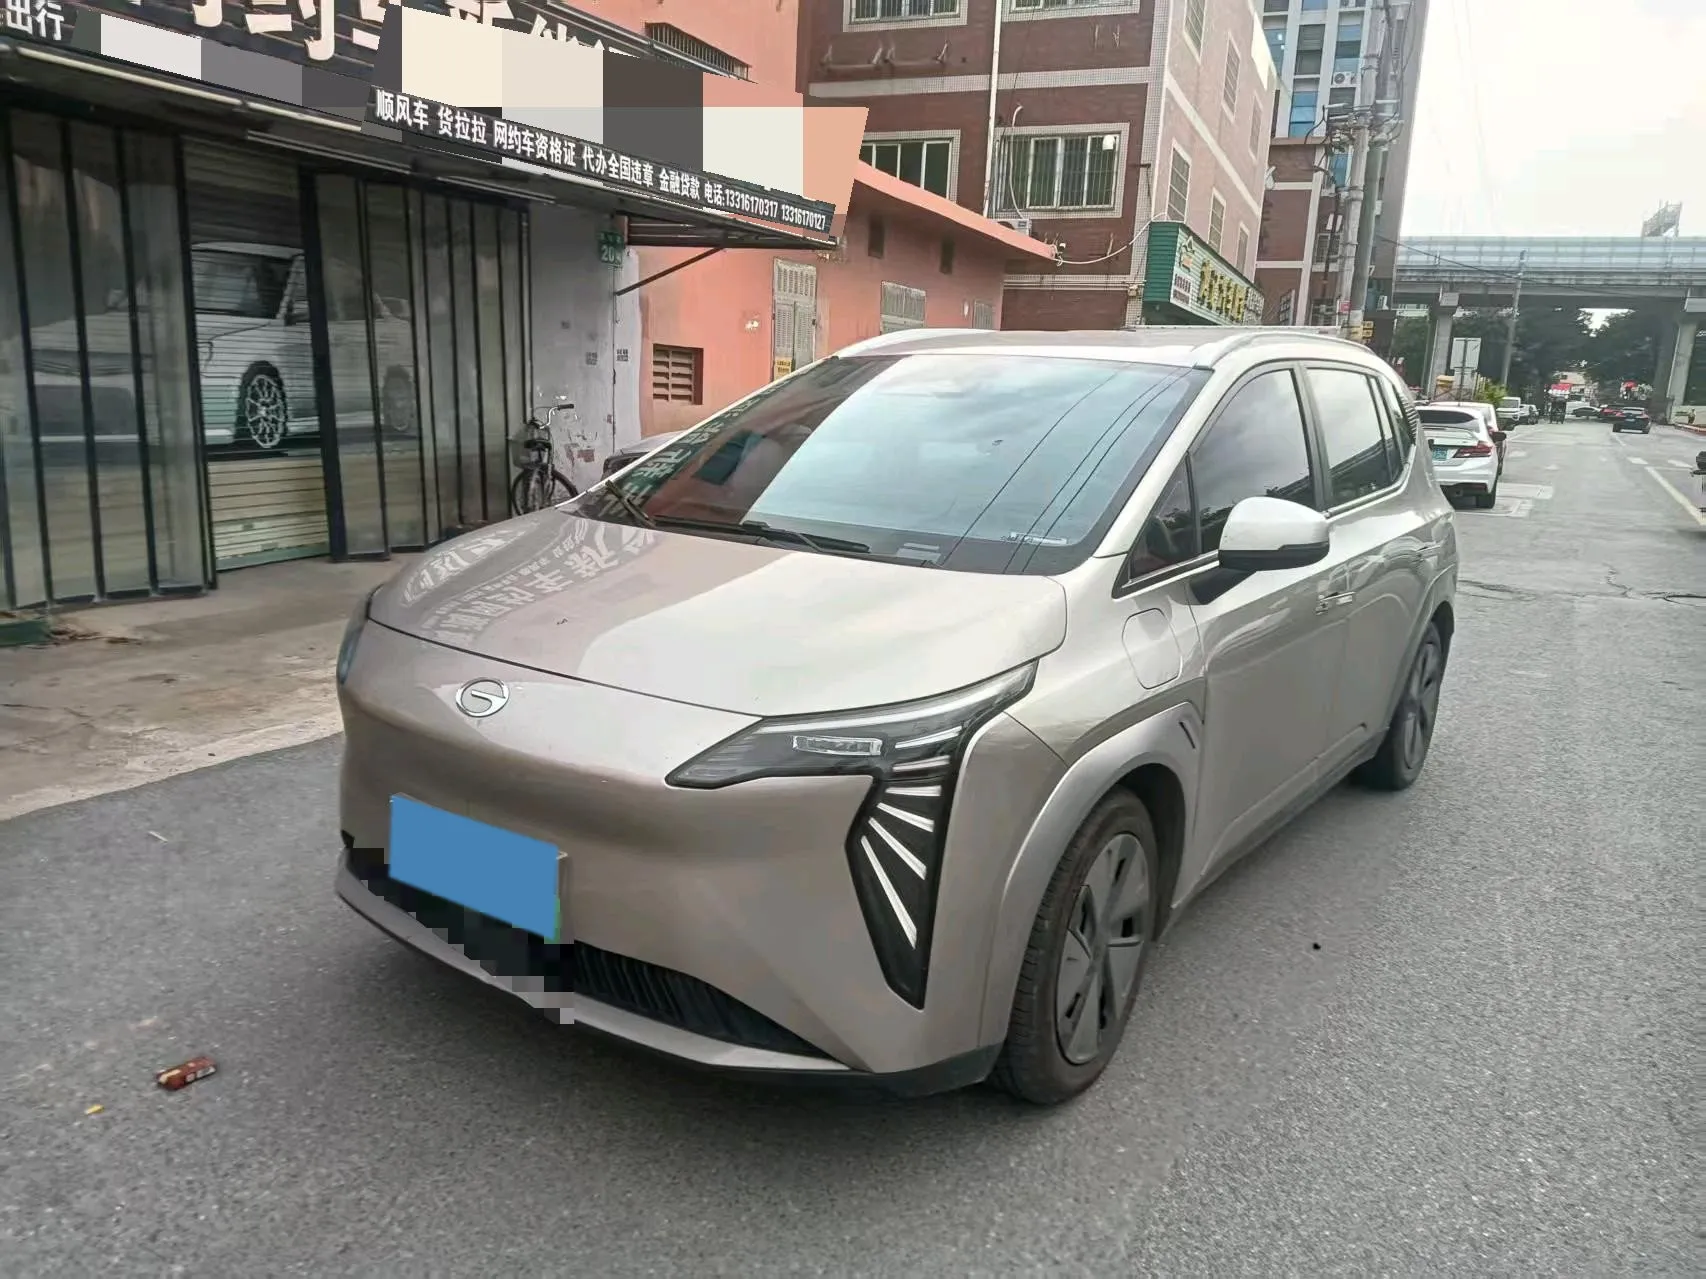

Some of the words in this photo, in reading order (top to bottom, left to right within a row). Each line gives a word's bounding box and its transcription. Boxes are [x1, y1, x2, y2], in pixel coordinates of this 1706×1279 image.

[376, 89, 429, 130] 顺风车
[438, 105, 487, 144] 货拉拉
[493, 120, 576, 167] 网约车资格证
[583, 145, 653, 187] 代办全国违章
[660, 168, 699, 199] 金融贷款
[704, 181, 778, 218] 电话:13316170317
[781, 204, 826, 231] 13316170127
